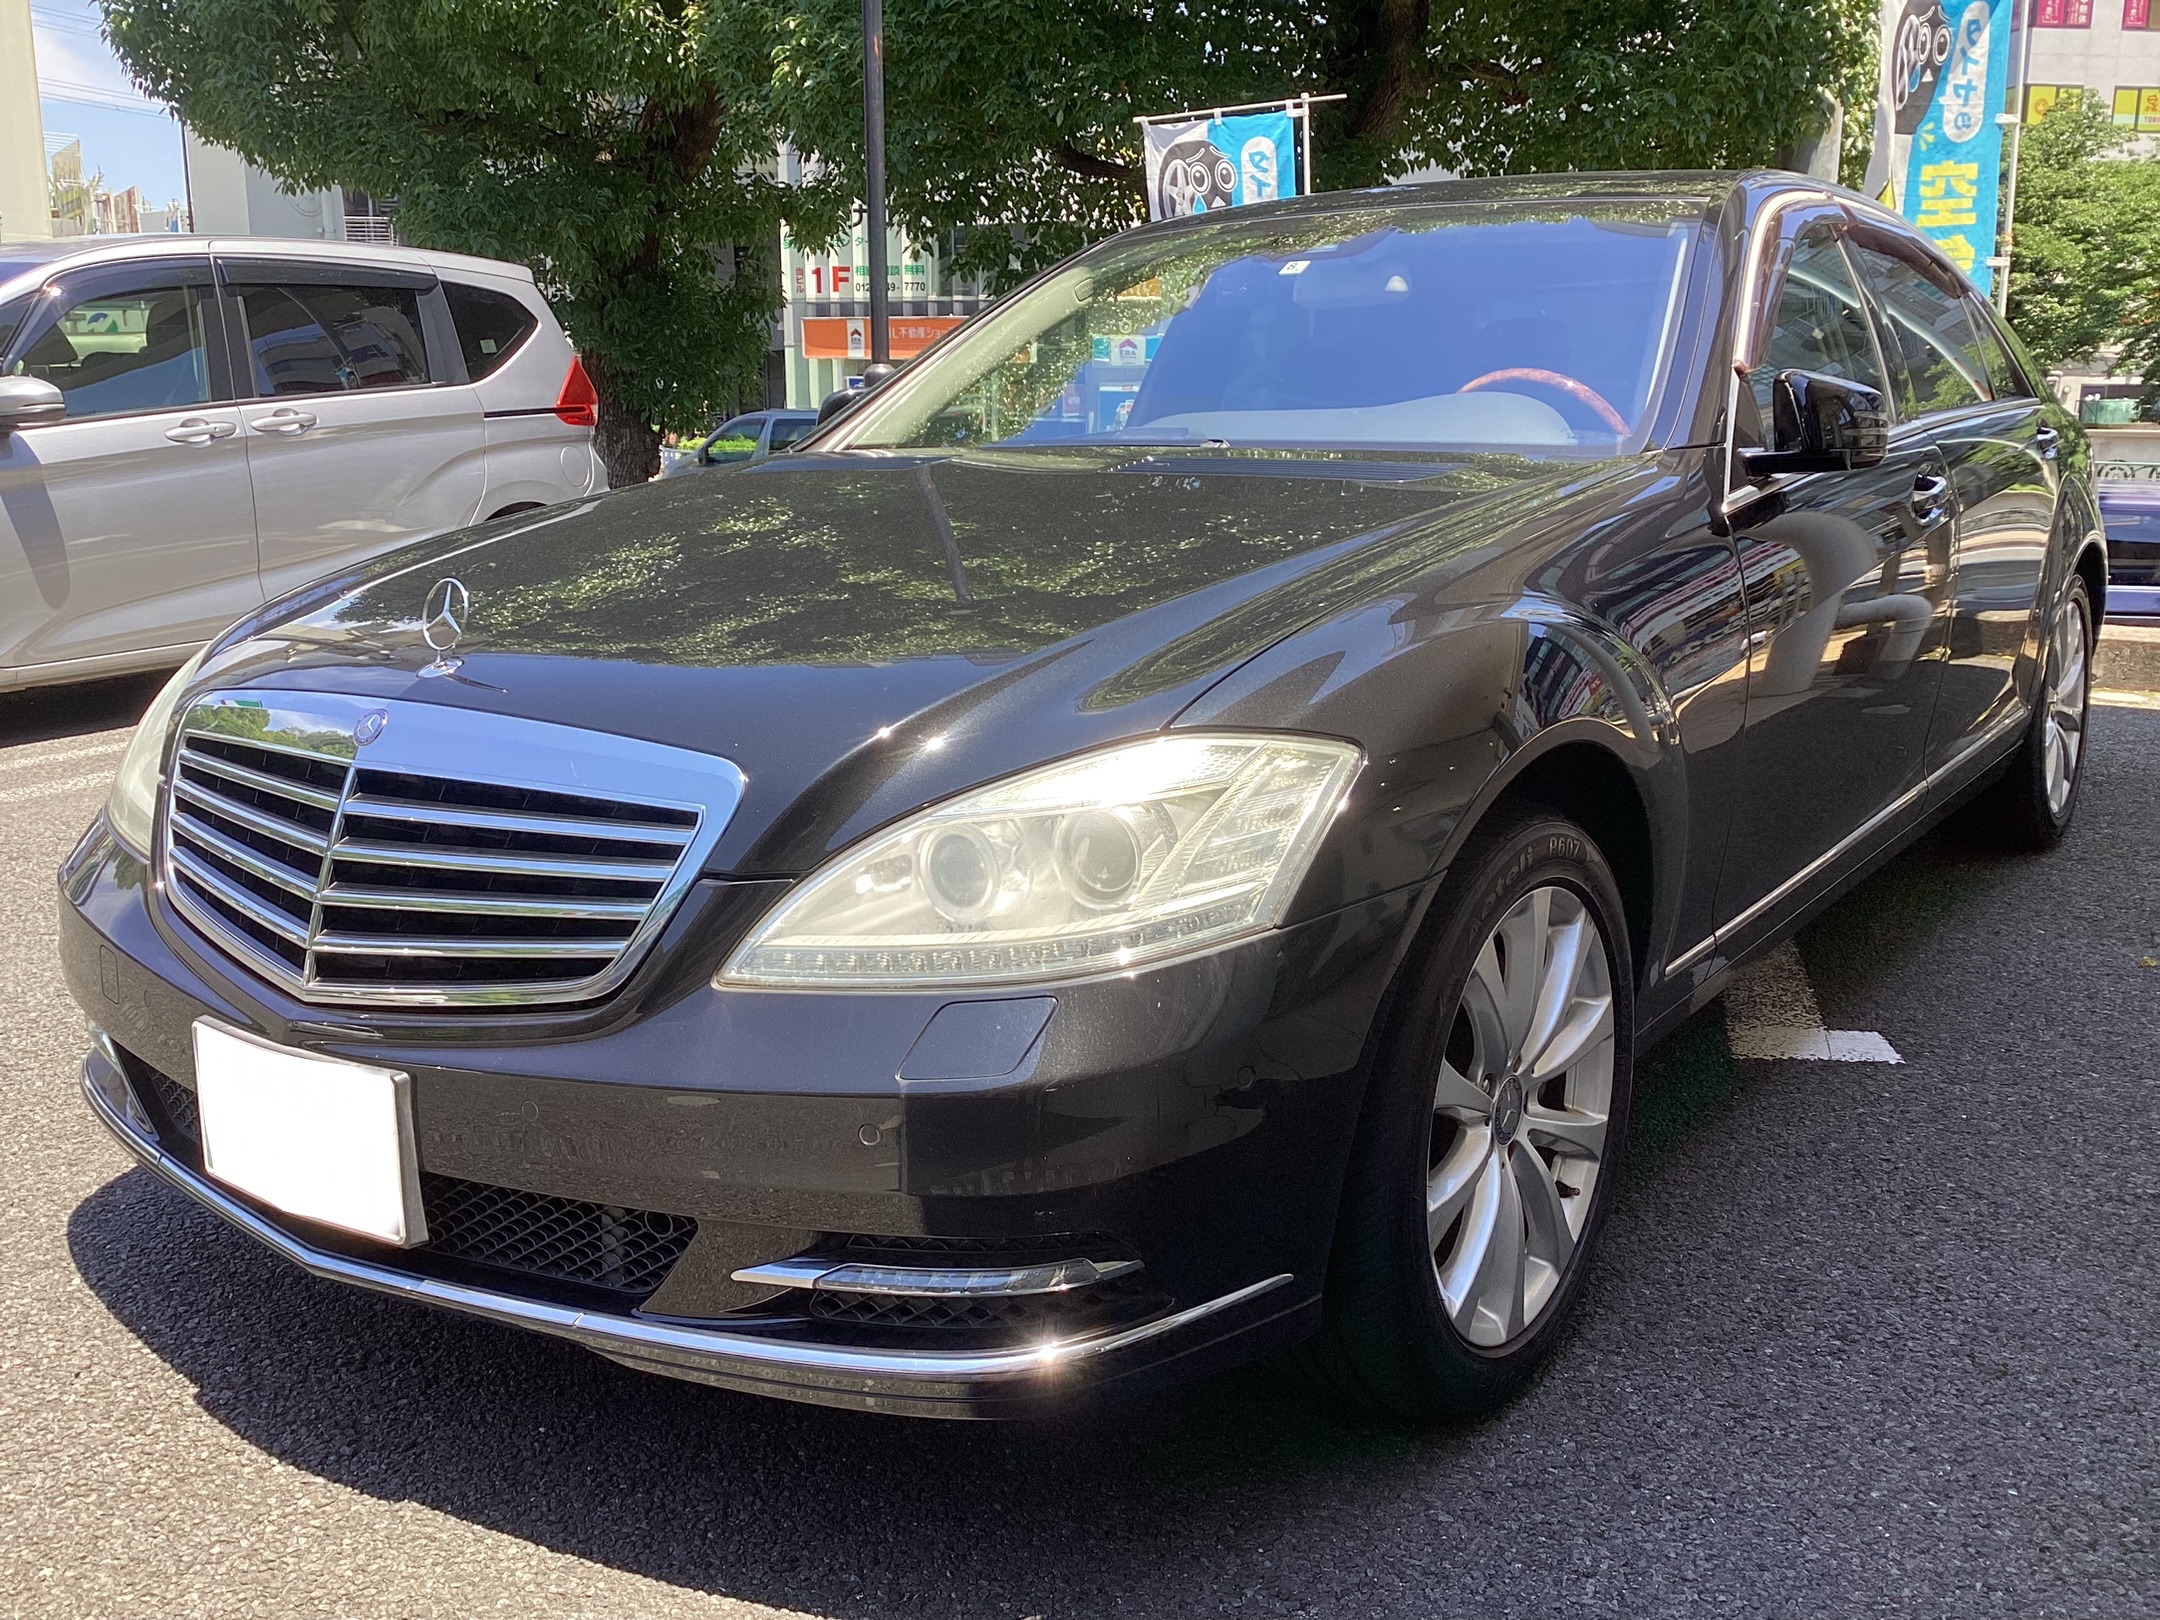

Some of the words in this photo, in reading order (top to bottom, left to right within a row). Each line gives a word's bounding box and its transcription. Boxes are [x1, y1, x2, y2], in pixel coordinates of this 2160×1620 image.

[904, 264, 925, 276] 無料
[811, 265, 850, 293] 1F
[904, 282, 926, 291] 7770
[1549, 836, 1582, 859] P607
